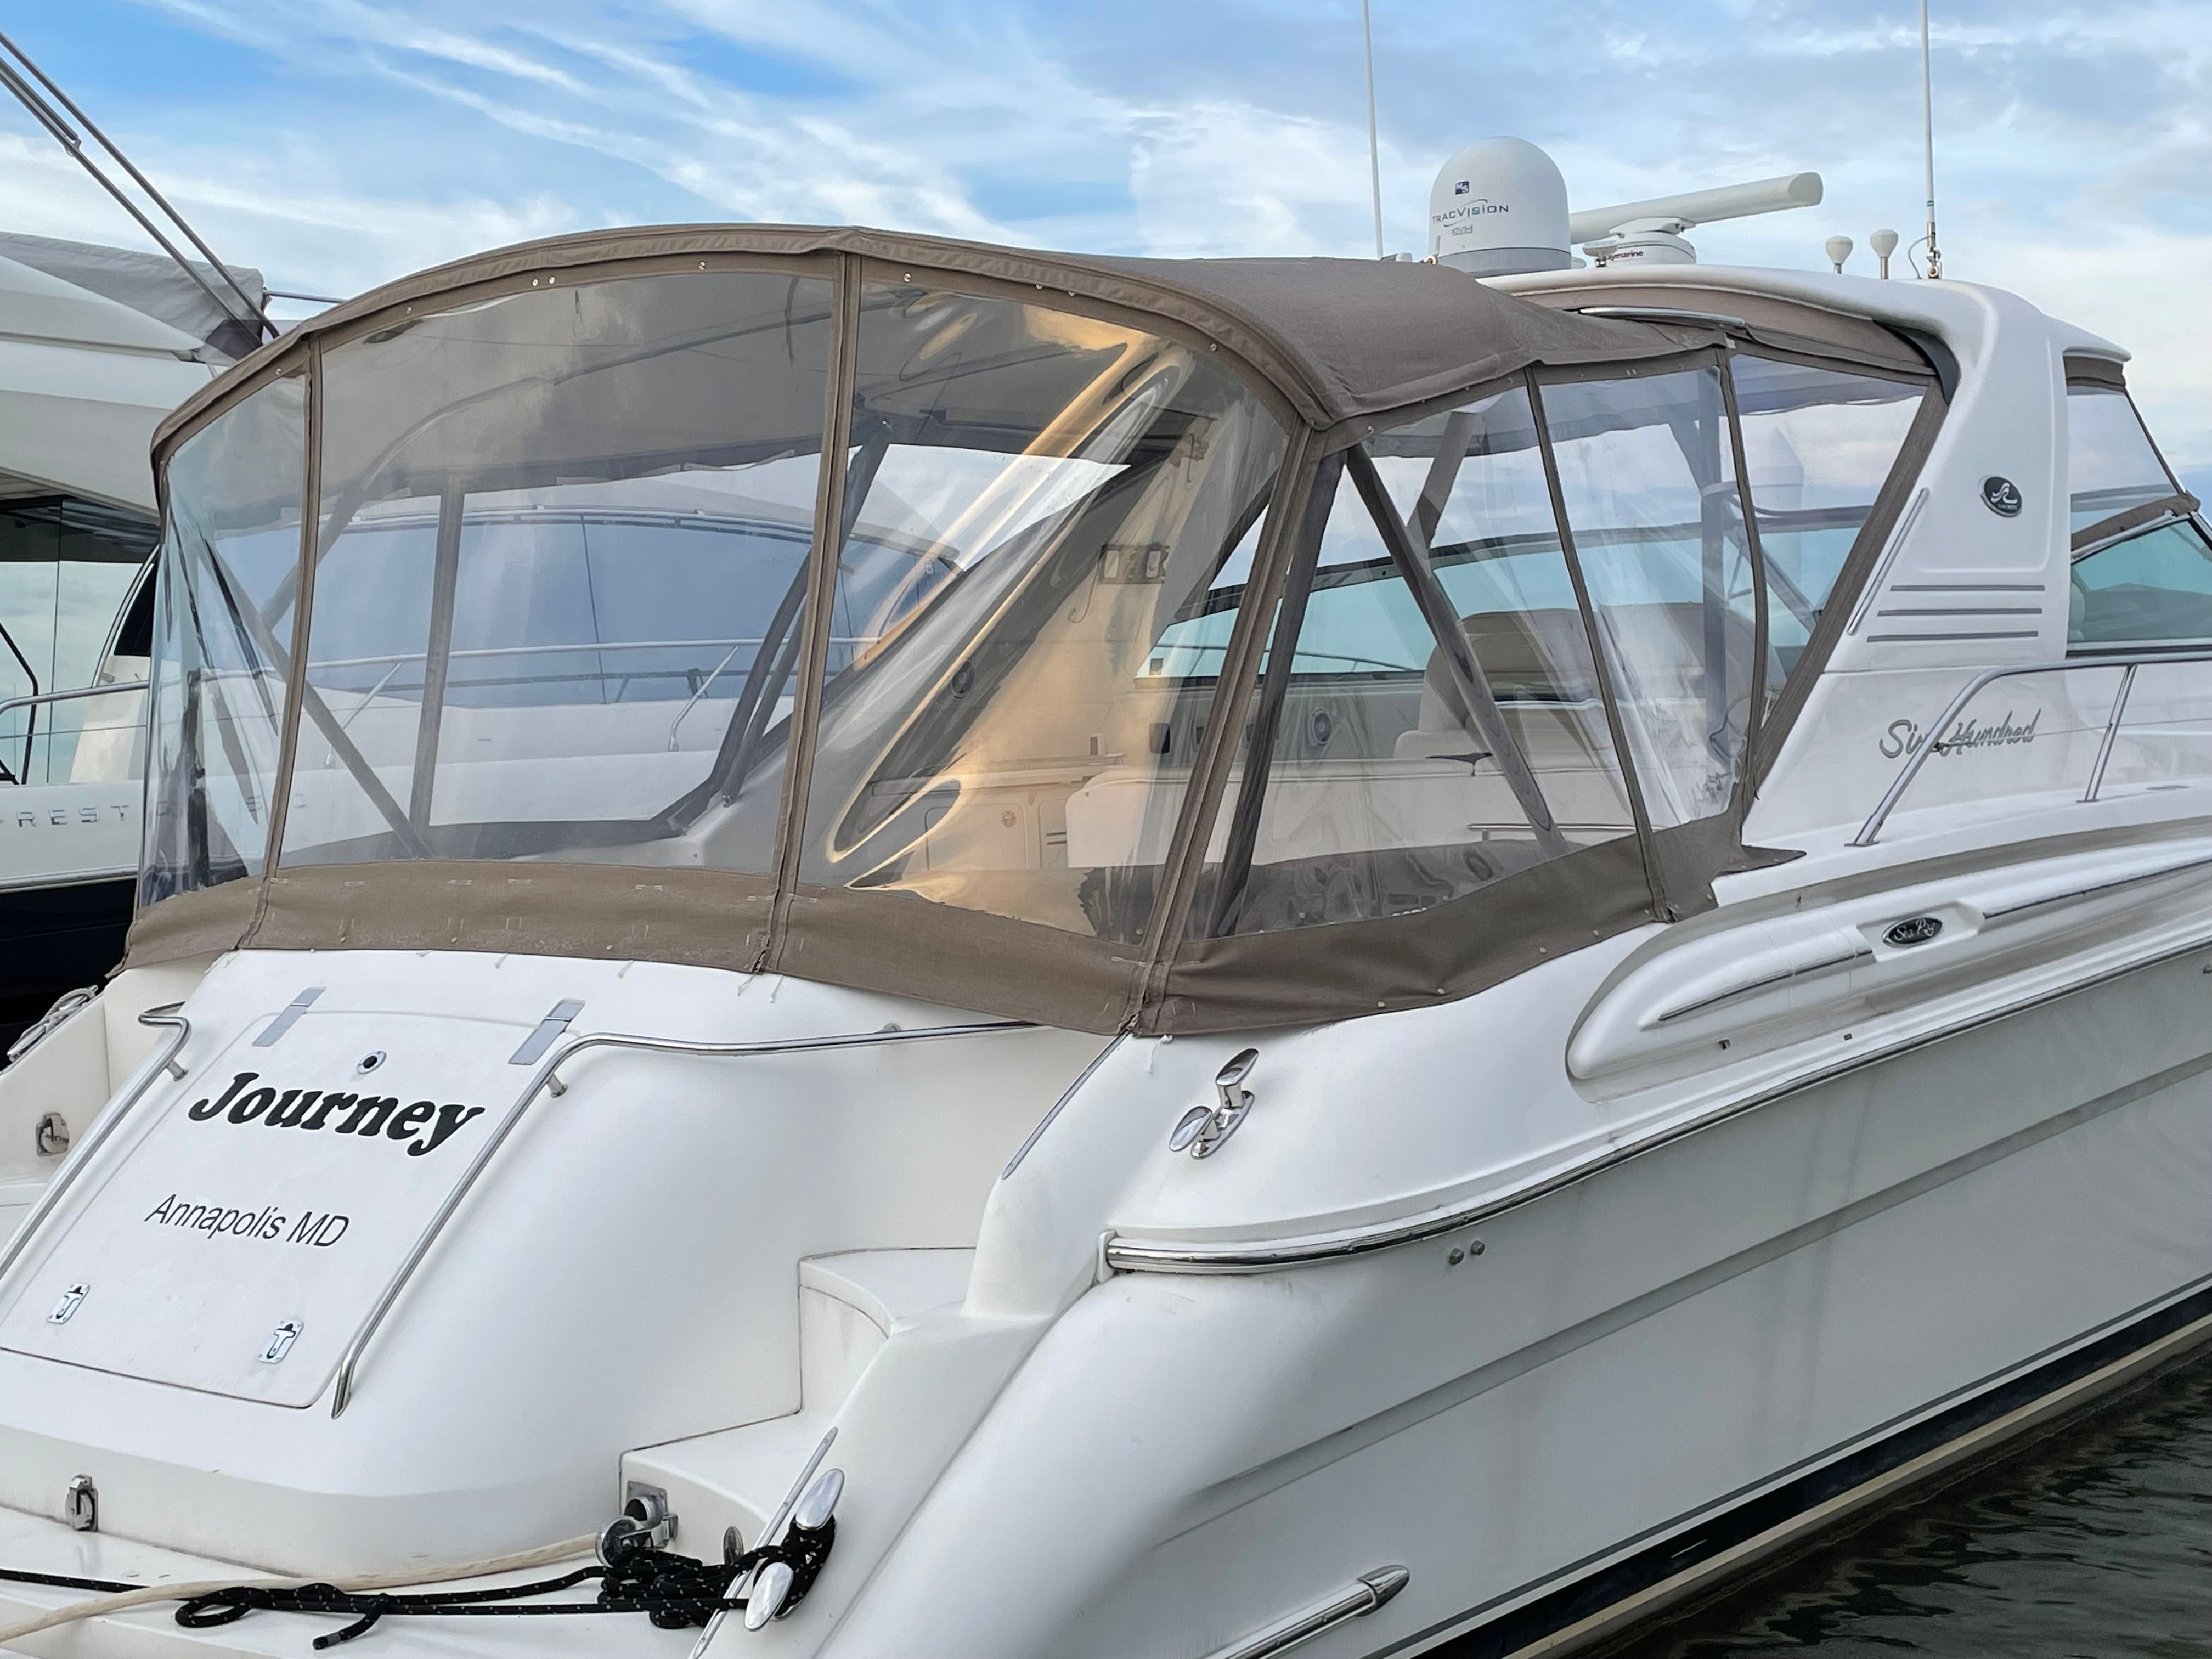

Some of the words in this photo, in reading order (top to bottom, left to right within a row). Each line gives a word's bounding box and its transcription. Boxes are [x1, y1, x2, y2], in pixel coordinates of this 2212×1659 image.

[0, 805, 129, 827] REST
[188, 1071, 486, 1156] Journey
[143, 1194, 286, 1239] Annapolis
[286, 1211, 349, 1247] MD
